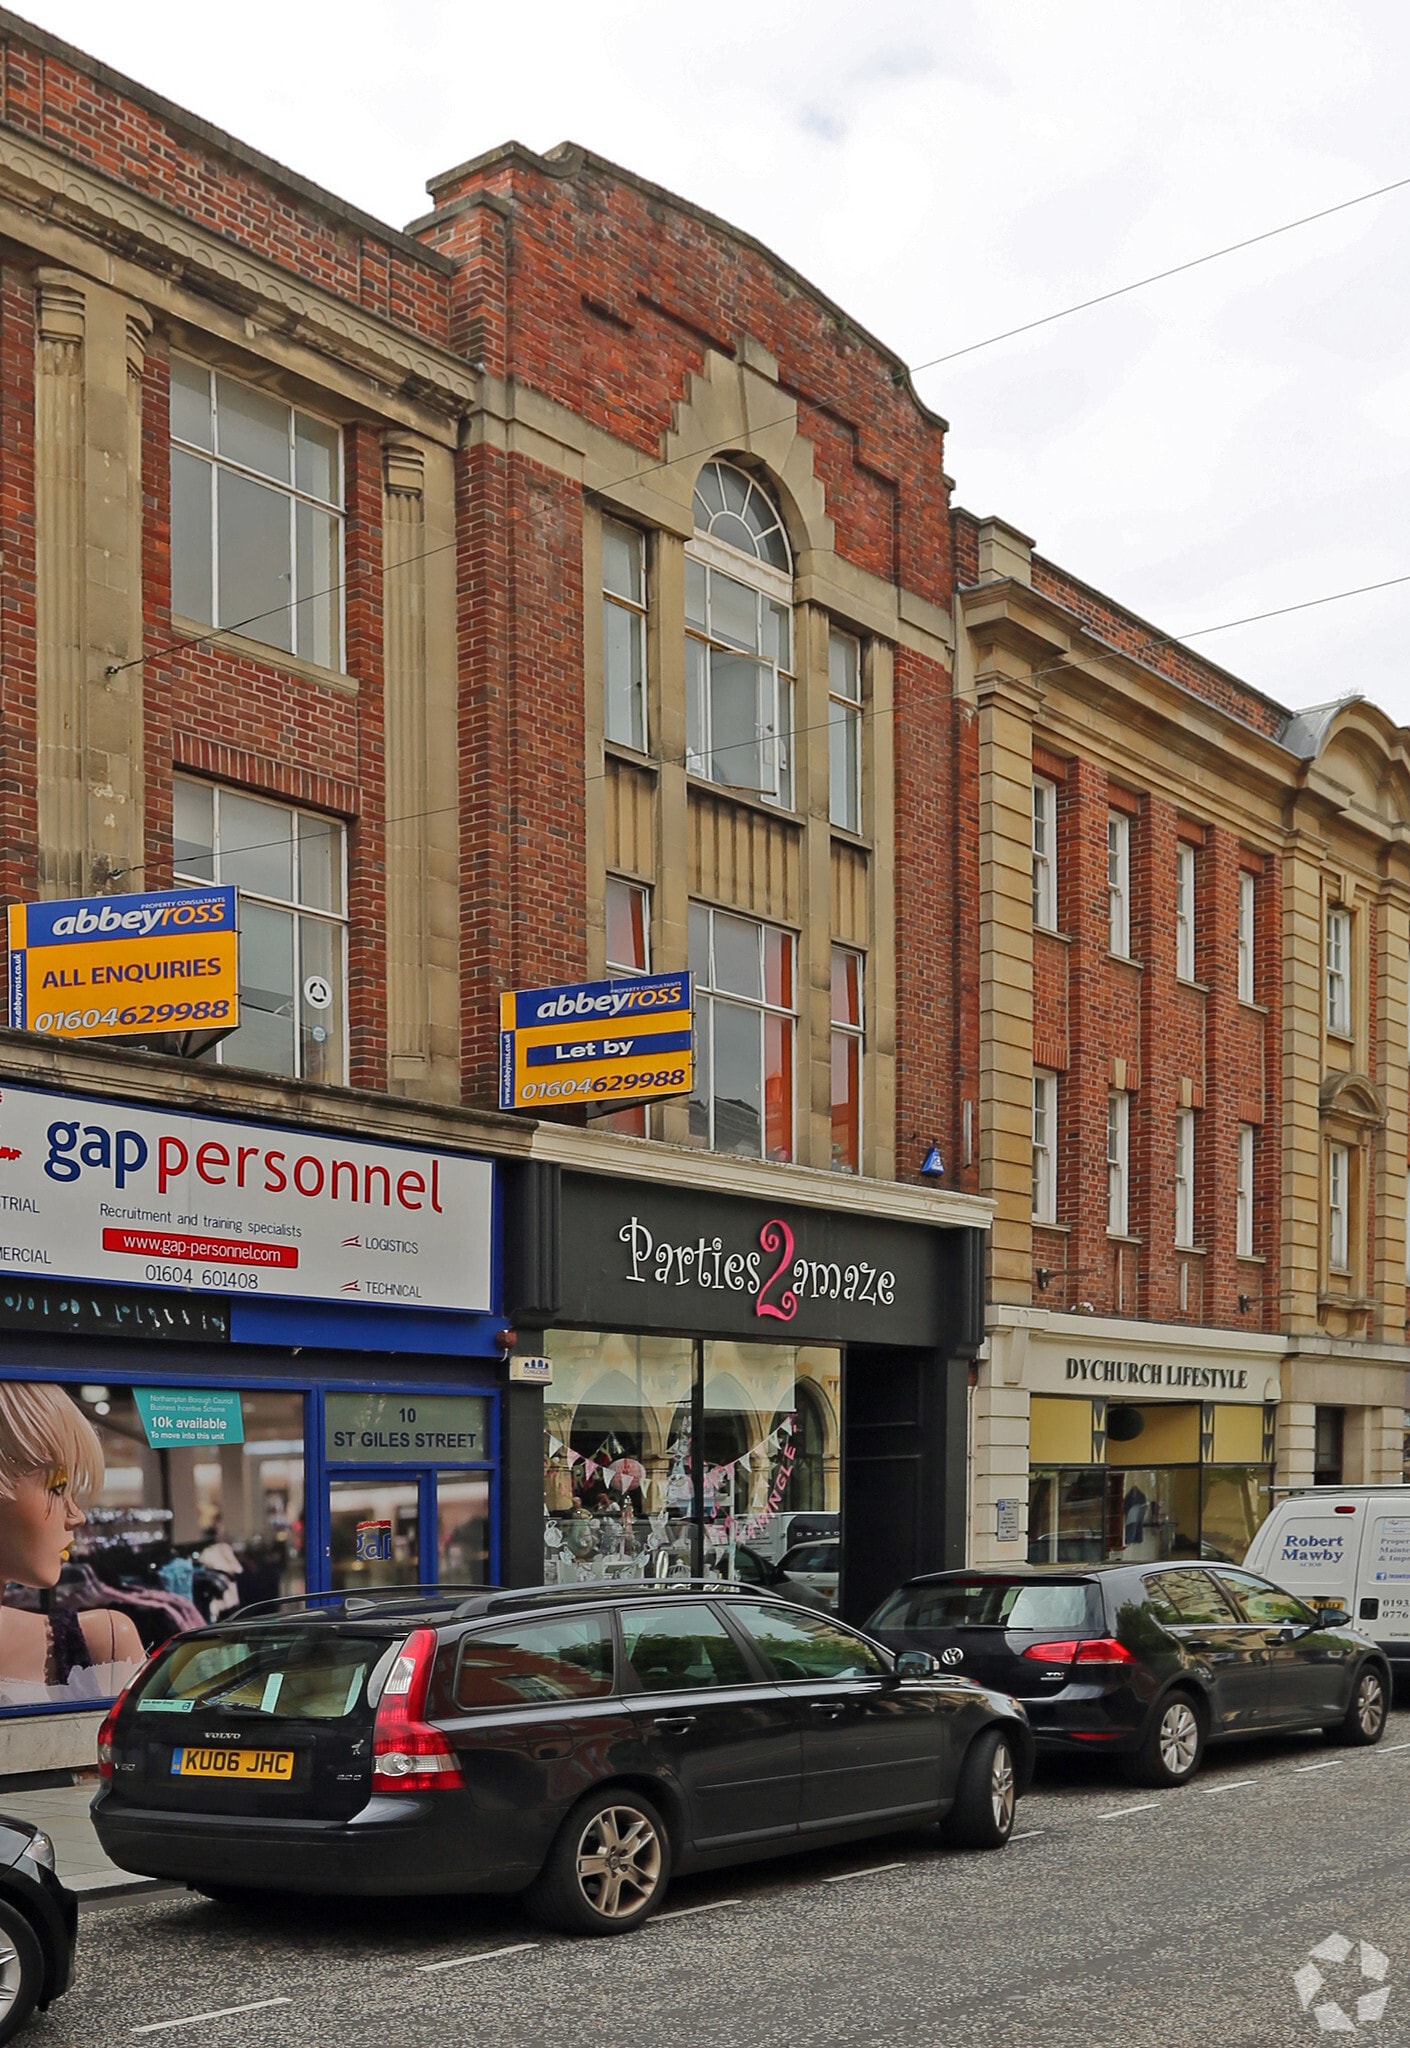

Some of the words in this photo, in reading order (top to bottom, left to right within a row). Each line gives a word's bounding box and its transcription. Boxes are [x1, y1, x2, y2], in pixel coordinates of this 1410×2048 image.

[141, 901, 176, 909] PROPERTY
[177, 897, 225, 906] CONSULTANTS
[42, 969, 86, 989] ALL
[92, 957, 222, 985] ENQUIRIES
[641, 981, 682, 990] CONSULTANTS
[556, 1043, 595, 1059] Let
[603, 1040, 634, 1056] by
[44, 1121, 148, 1189] gap
[158, 1136, 443, 1213] personnel
[0, 1195, 40, 1214] TRIAL
[100, 1203, 172, 1223] Recruitment
[177, 1214, 198, 1226] and
[204, 1215, 243, 1233] training
[248, 1222, 302, 1238] specialists
[123, 1234, 282, 1262] www.gap-personnel.com
[365, 1237, 419, 1254] LOGISTICS
[145, 1264, 193, 1284] 01604
[202, 1269, 258, 1289] 601408
[365, 1281, 422, 1298] TECHNICAL
[1066, 1357, 1162, 1385] DYCHURCH
[1166, 1364, 1249, 1389] LIFESTYLE
[150, 1395, 187, 1404] Northampton
[188, 1396, 212, 1405] Borough
[151, 1416, 173, 1428] 10k
[176, 1417, 227, 1429] available
[399, 1408, 416, 1423] 10
[150, 1431, 159, 1439] To
[182, 1431, 195, 1439] into
[197, 1431, 209, 1439] this
[211, 1432, 224, 1440] unit
[334, 1431, 355, 1447] ST
[361, 1432, 410, 1447] GILES
[415, 1432, 476, 1448] STREET
[1285, 1535, 1344, 1547] Robert
[1281, 1548, 1344, 1564] Mawby
[204, 1732, 241, 1740] VOLVO
[185, 1751, 241, 1772] KU06
[246, 1753, 289, 1774] JHC
